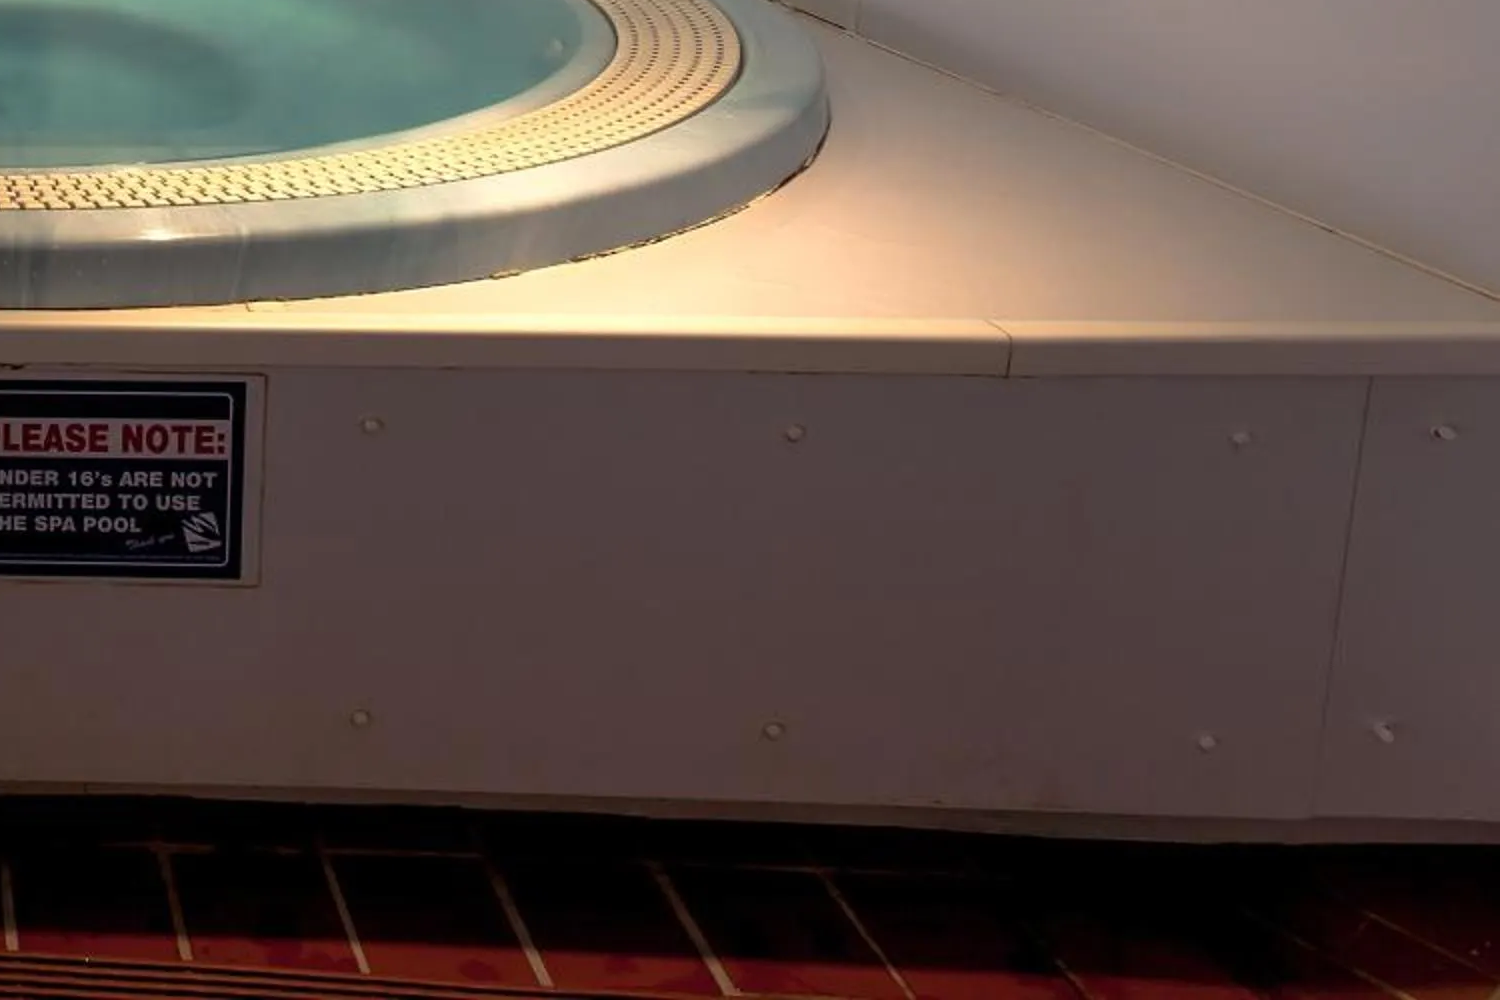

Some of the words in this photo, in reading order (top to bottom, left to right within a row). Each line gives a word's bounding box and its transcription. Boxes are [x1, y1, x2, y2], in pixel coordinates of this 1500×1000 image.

[121, 424, 226, 455] NOTE:
[68, 471, 112, 487] 16's
[119, 471, 163, 488] ARE
[171, 472, 217, 488] NOT
[118, 494, 148, 510] TO
[155, 494, 200, 511] USE
[34, 516, 76, 532] SPA
[83, 516, 142, 533] POOL
